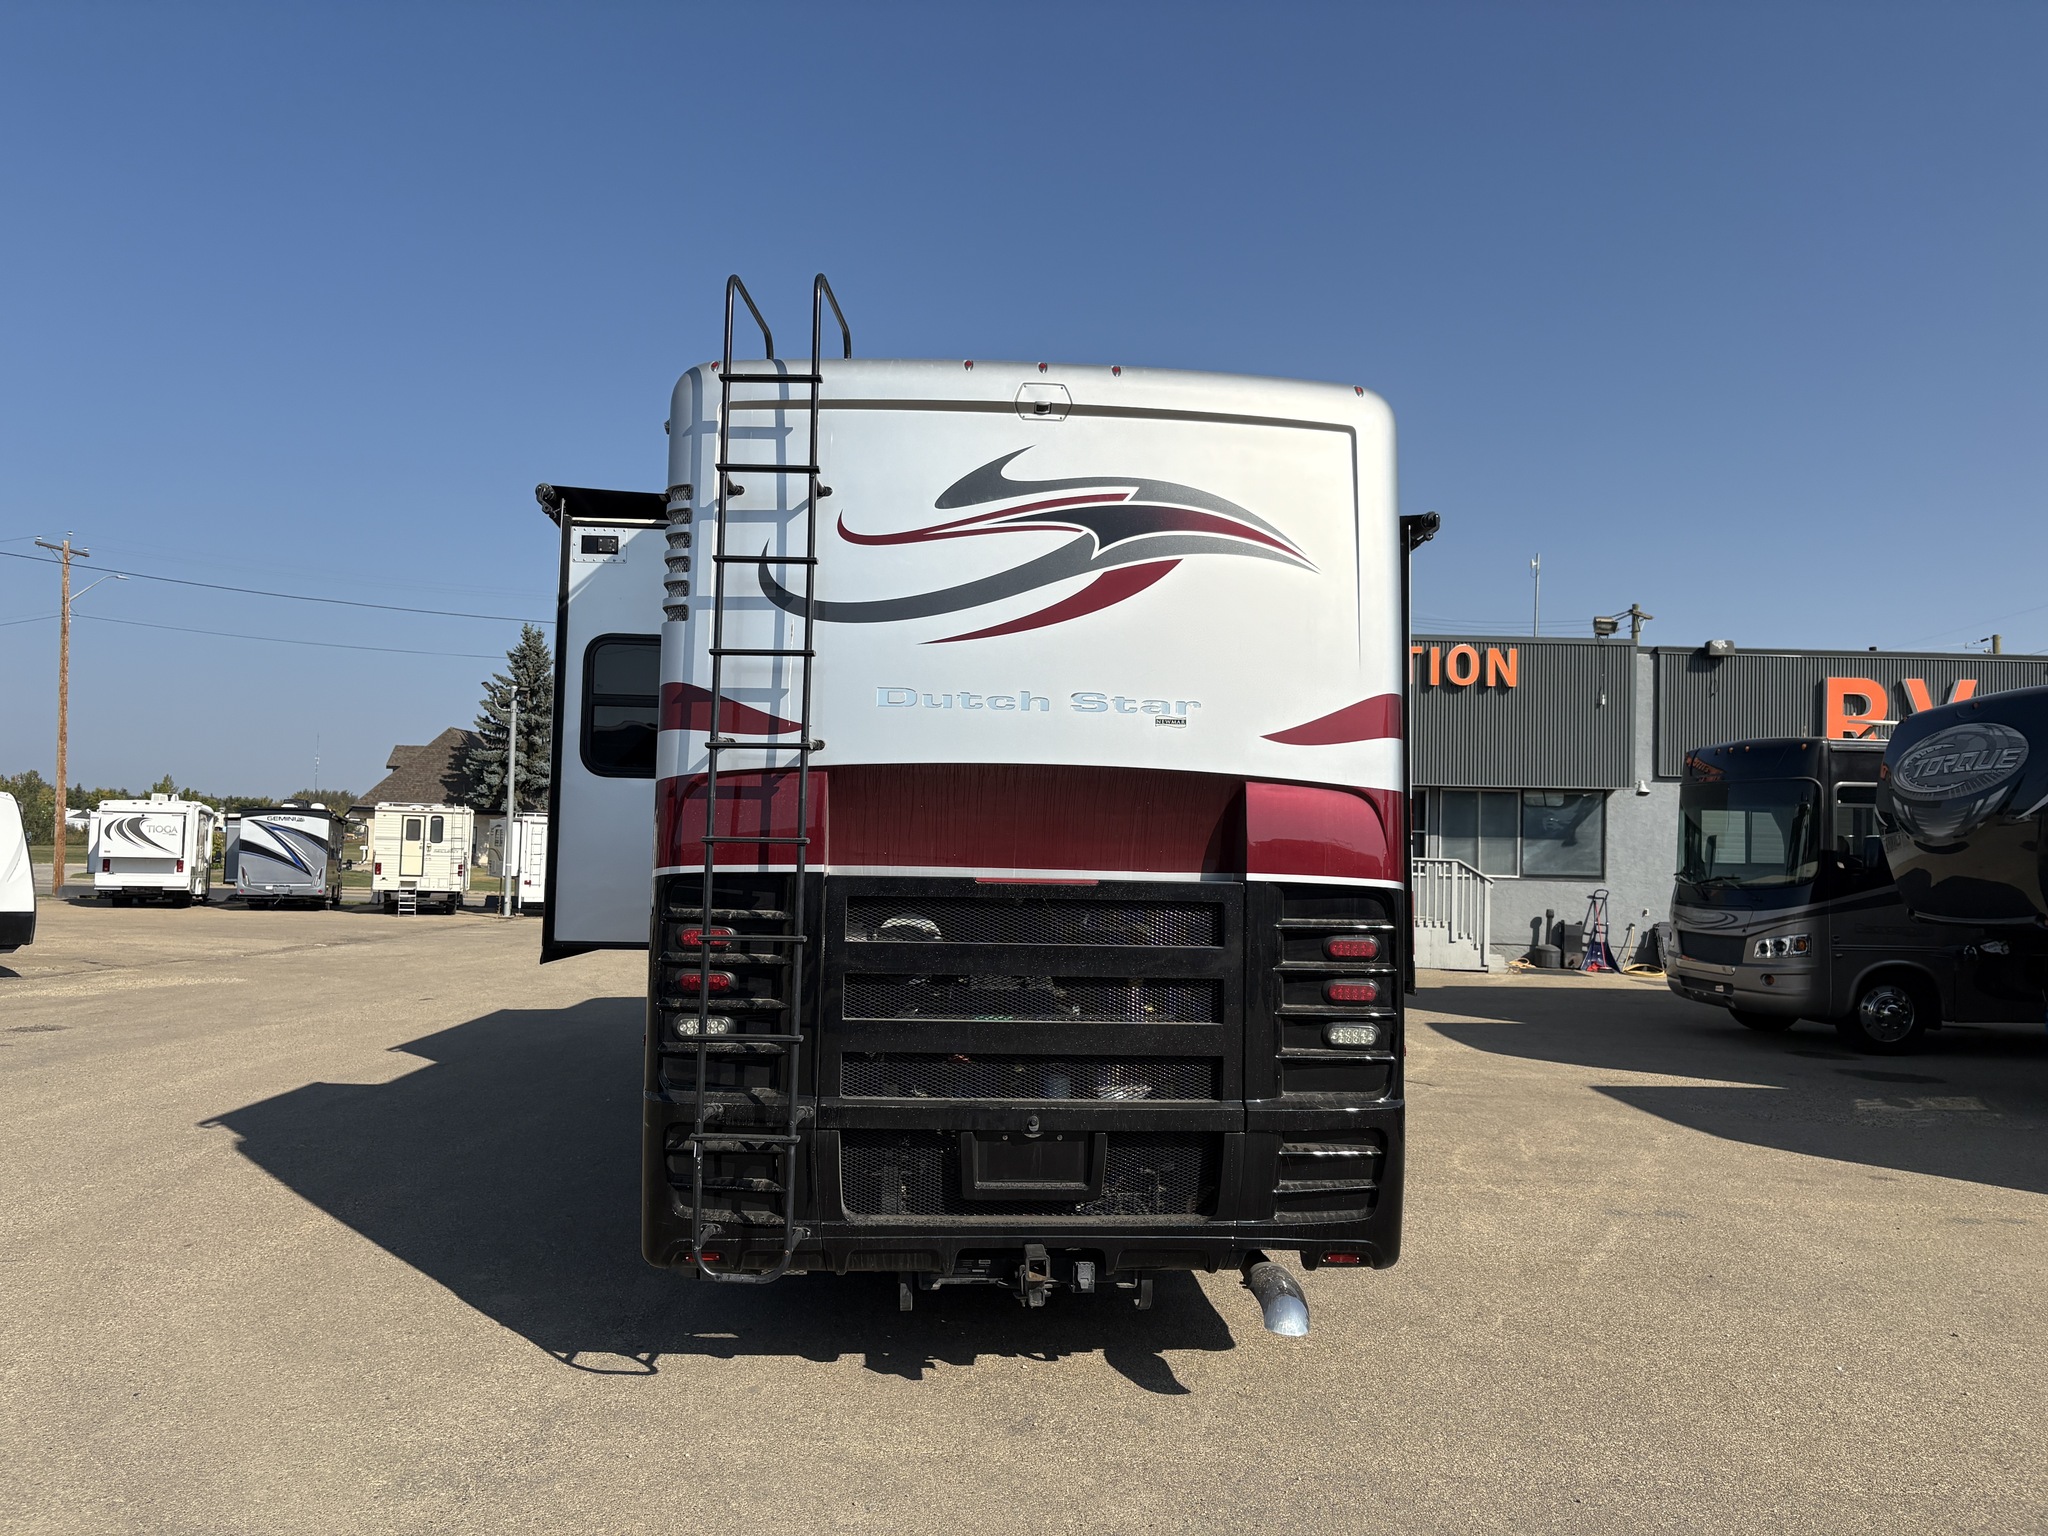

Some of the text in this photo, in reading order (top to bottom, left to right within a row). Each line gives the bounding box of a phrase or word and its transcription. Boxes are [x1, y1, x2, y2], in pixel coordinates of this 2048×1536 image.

[876, 686, 1202, 716] Dutch Star
[1913, 747, 2026, 779] TORQUE
[146, 825, 178, 834] TIOGA
